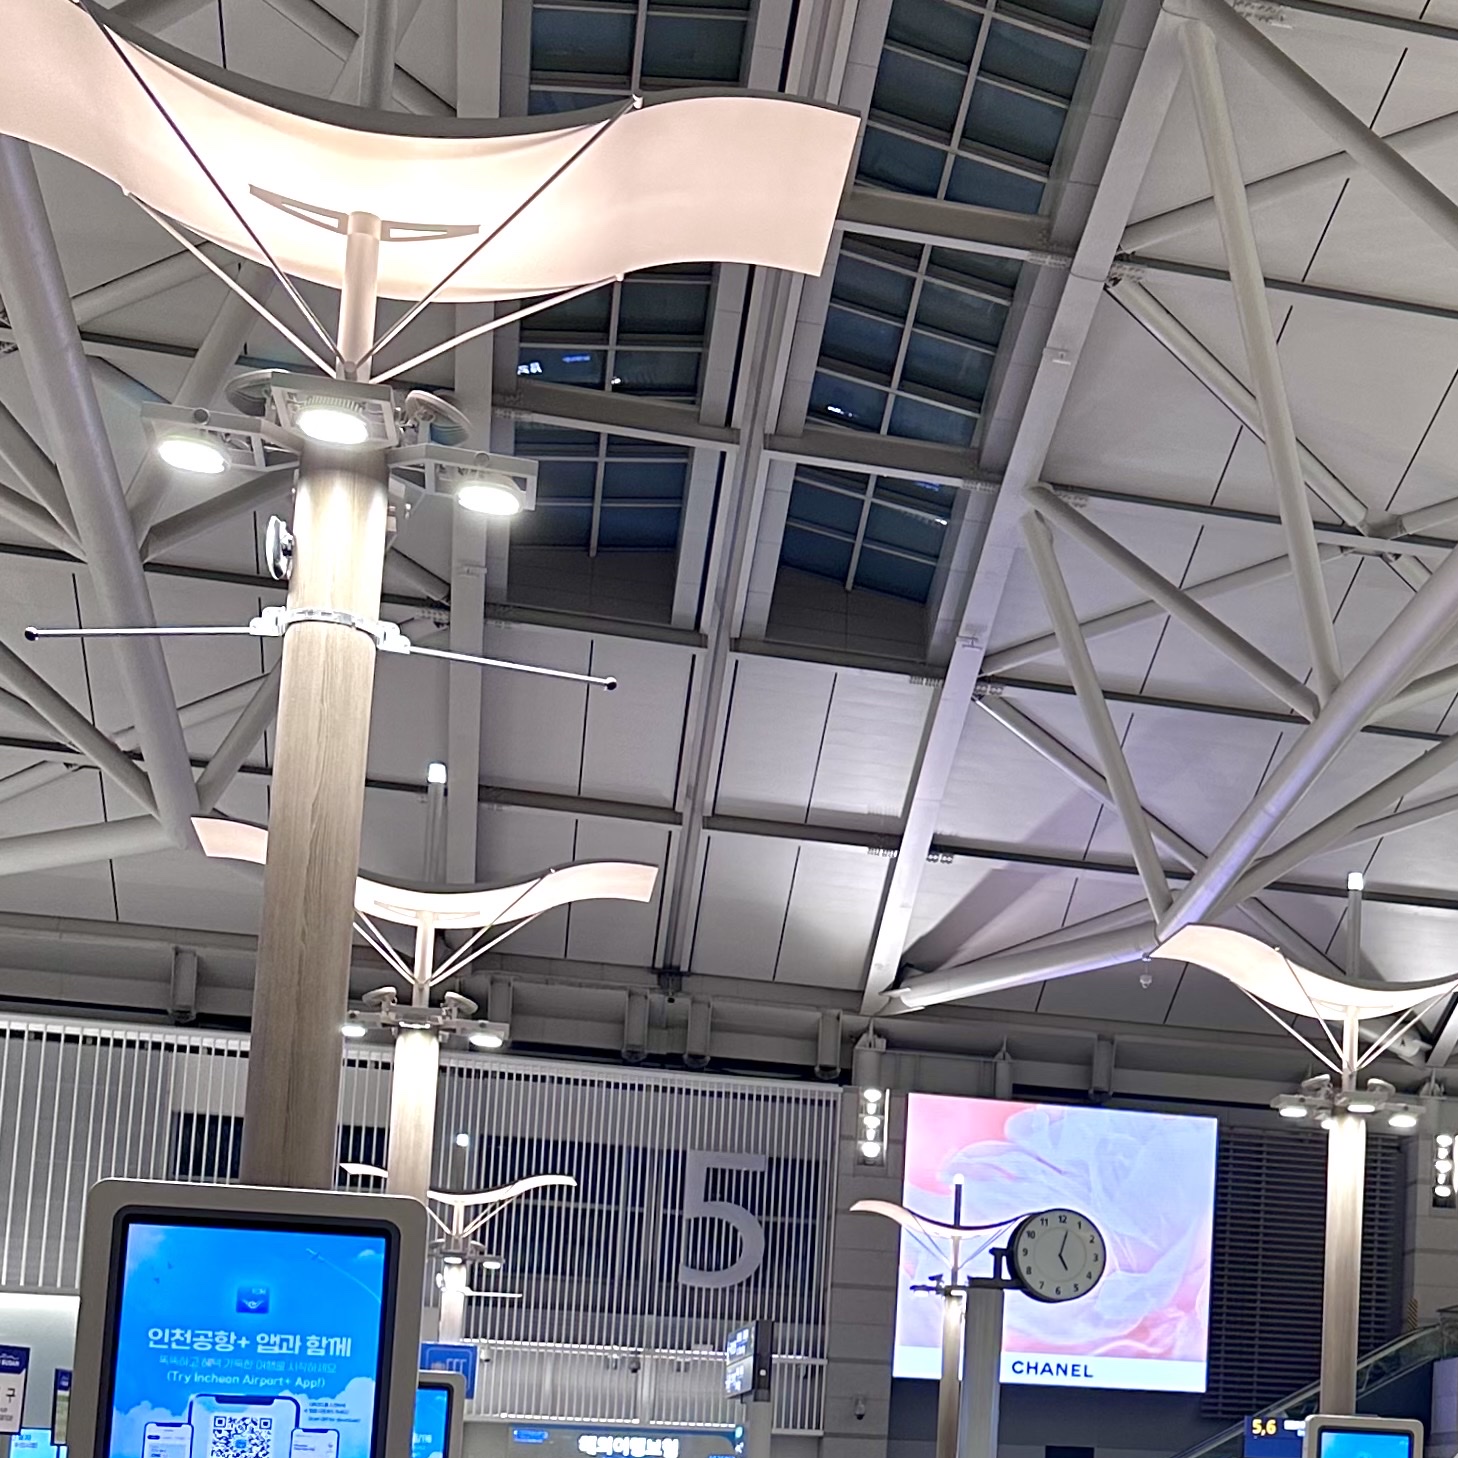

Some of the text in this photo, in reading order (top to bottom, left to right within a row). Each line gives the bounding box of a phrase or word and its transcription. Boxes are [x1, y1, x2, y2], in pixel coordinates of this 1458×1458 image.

[678, 1149, 766, 1289] 5
[1040, 1217, 1049, 1227] 11
[1058, 1214, 1068, 1224] 12
[1077, 1220, 1082, 1230] 1
[1026, 1230, 1036, 1240] 10
[1089, 1234, 1095, 1244] 2
[1022, 1247, 1029, 1257] 9
[1093, 1253, 1099, 1262] 3
[1026, 1266, 1032, 1275] 8
[1086, 1271, 1092, 1280] 4
[1039, 1281, 1045, 1290] 7
[1073, 1283, 1079, 1293] 5
[1055, 1286, 1061, 1296] 6
[148, 1327, 251, 1352] 인천공항+
[256, 1333, 302, 1355] 앱과
[1011, 1360, 1094, 1378] CHANEL
[1251, 1418, 1277, 1437] 5,6
